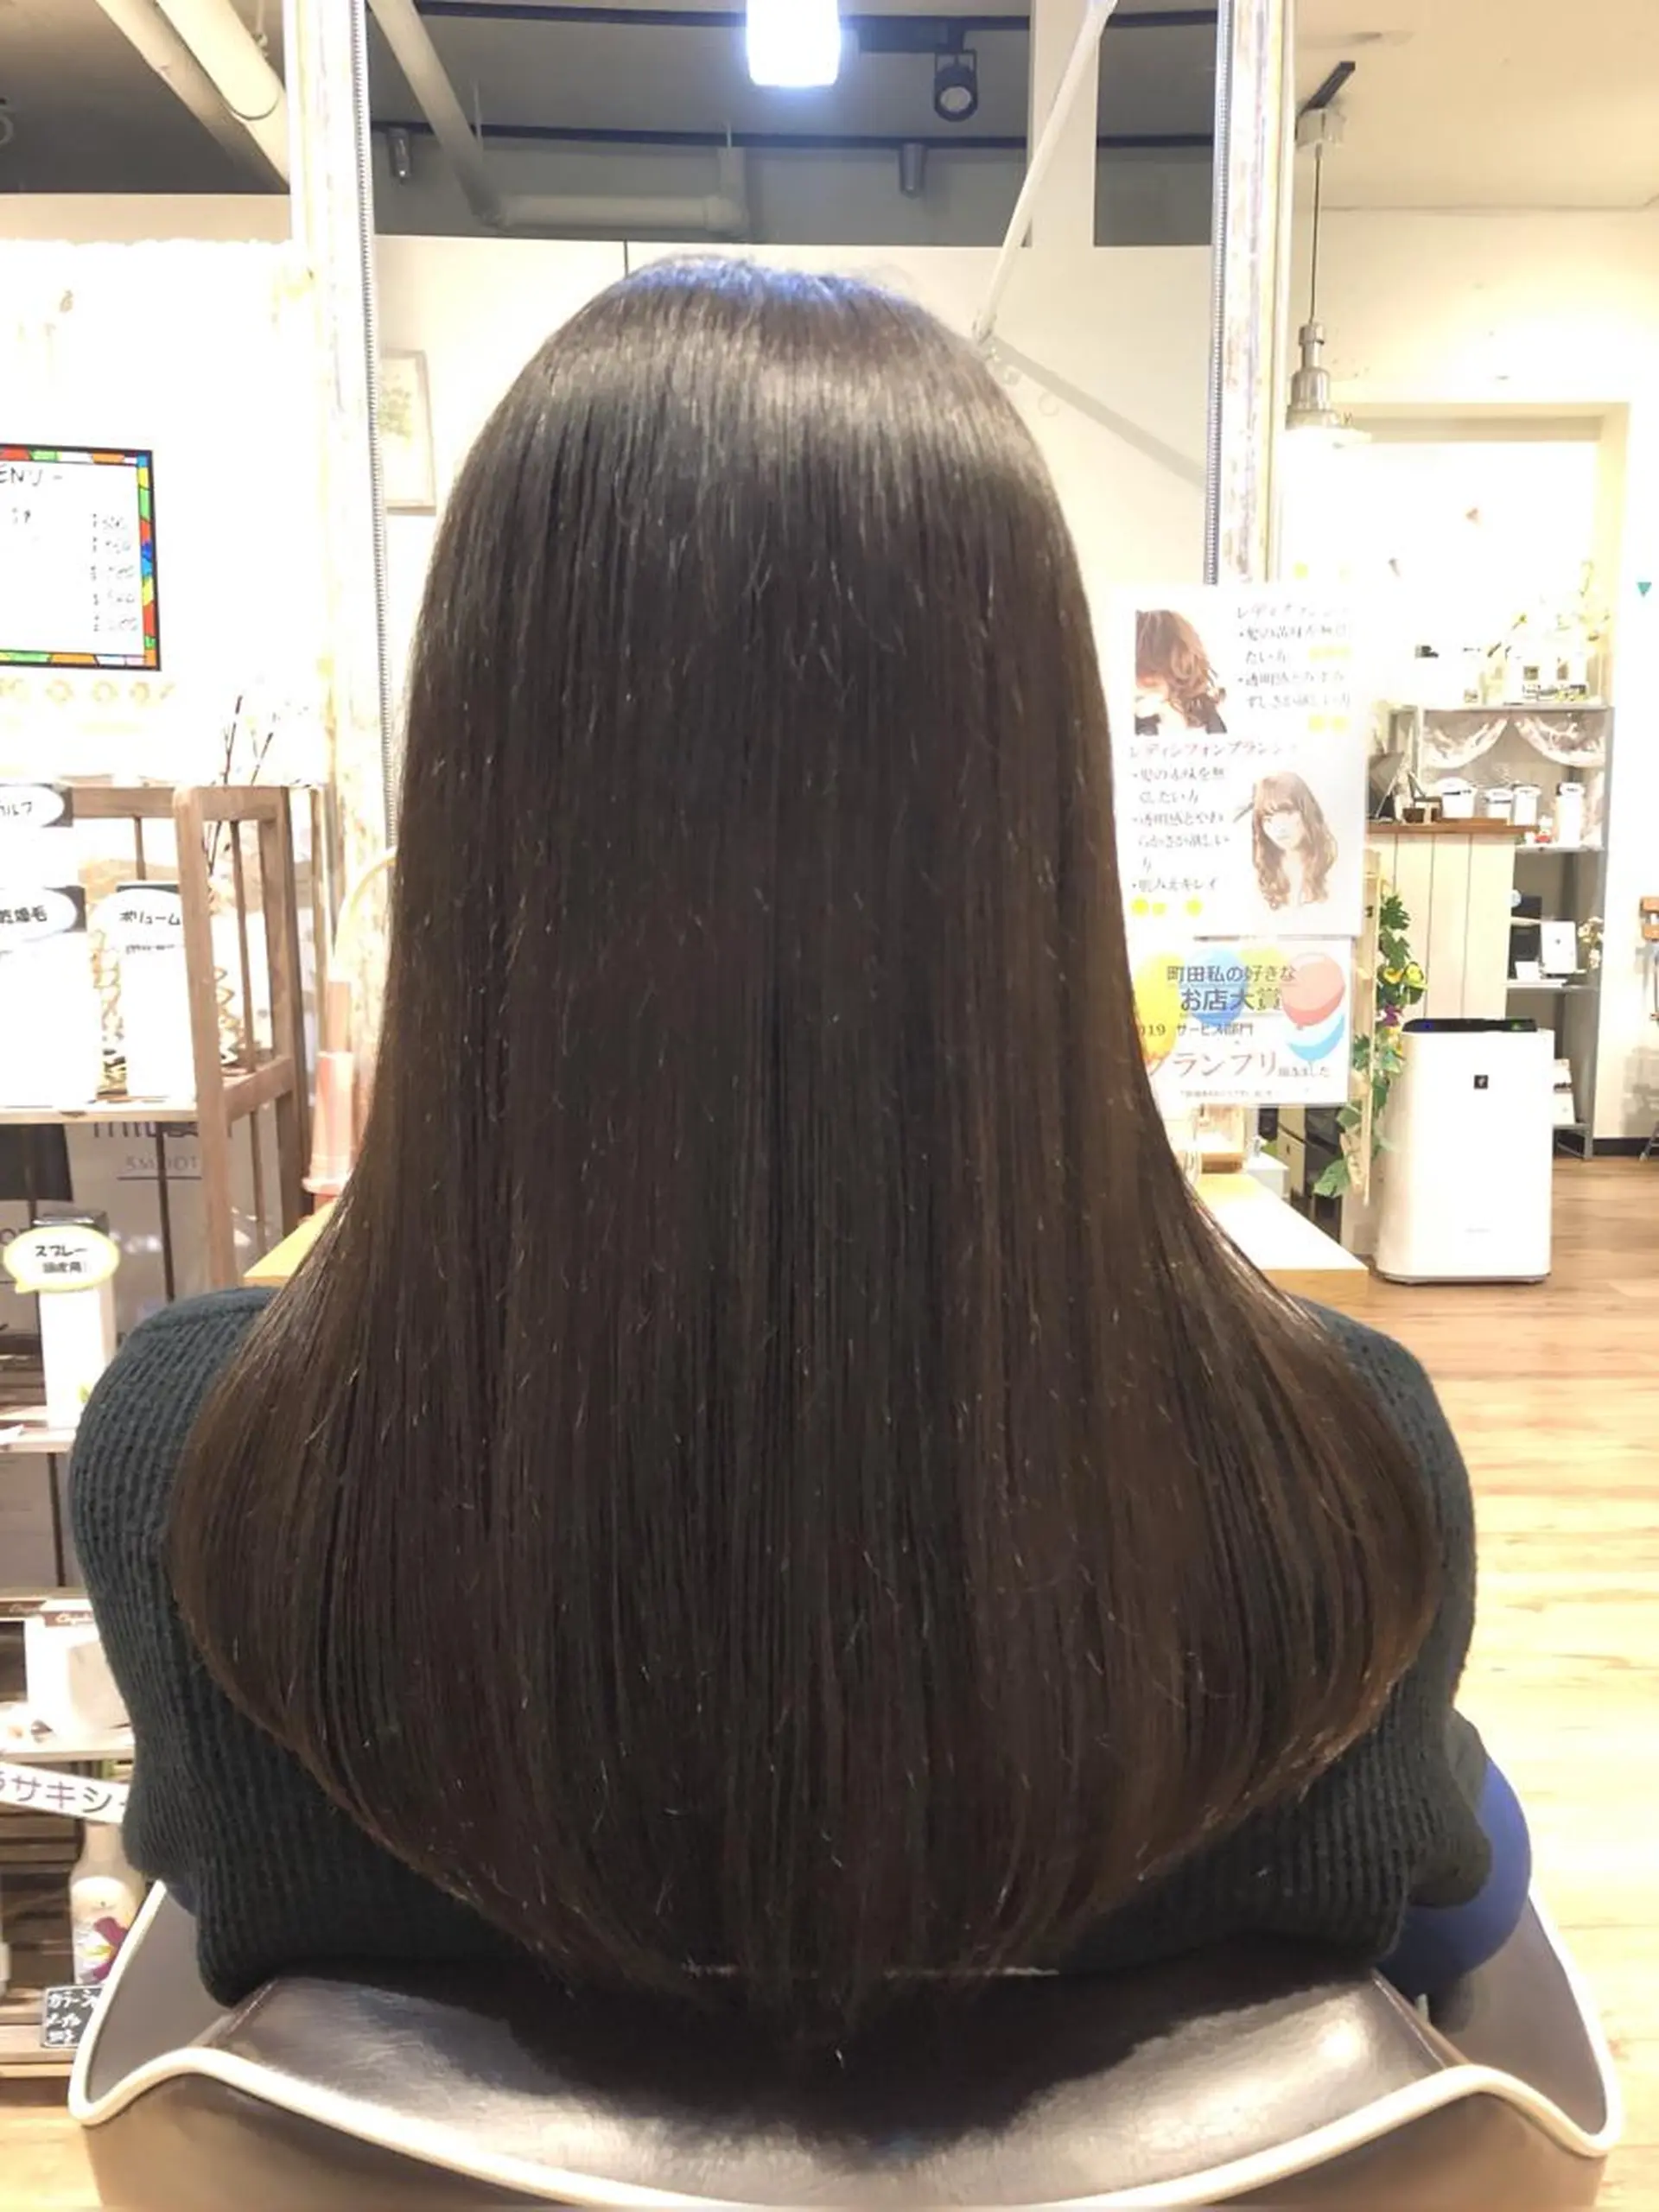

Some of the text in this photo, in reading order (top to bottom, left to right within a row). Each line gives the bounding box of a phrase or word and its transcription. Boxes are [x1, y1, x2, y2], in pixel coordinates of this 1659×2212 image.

[1166, 964, 1297, 983] 町田私の好きな
[1180, 988, 1283, 1012] お店大賞
[1176, 1022, 1254, 1037] サービス部門
